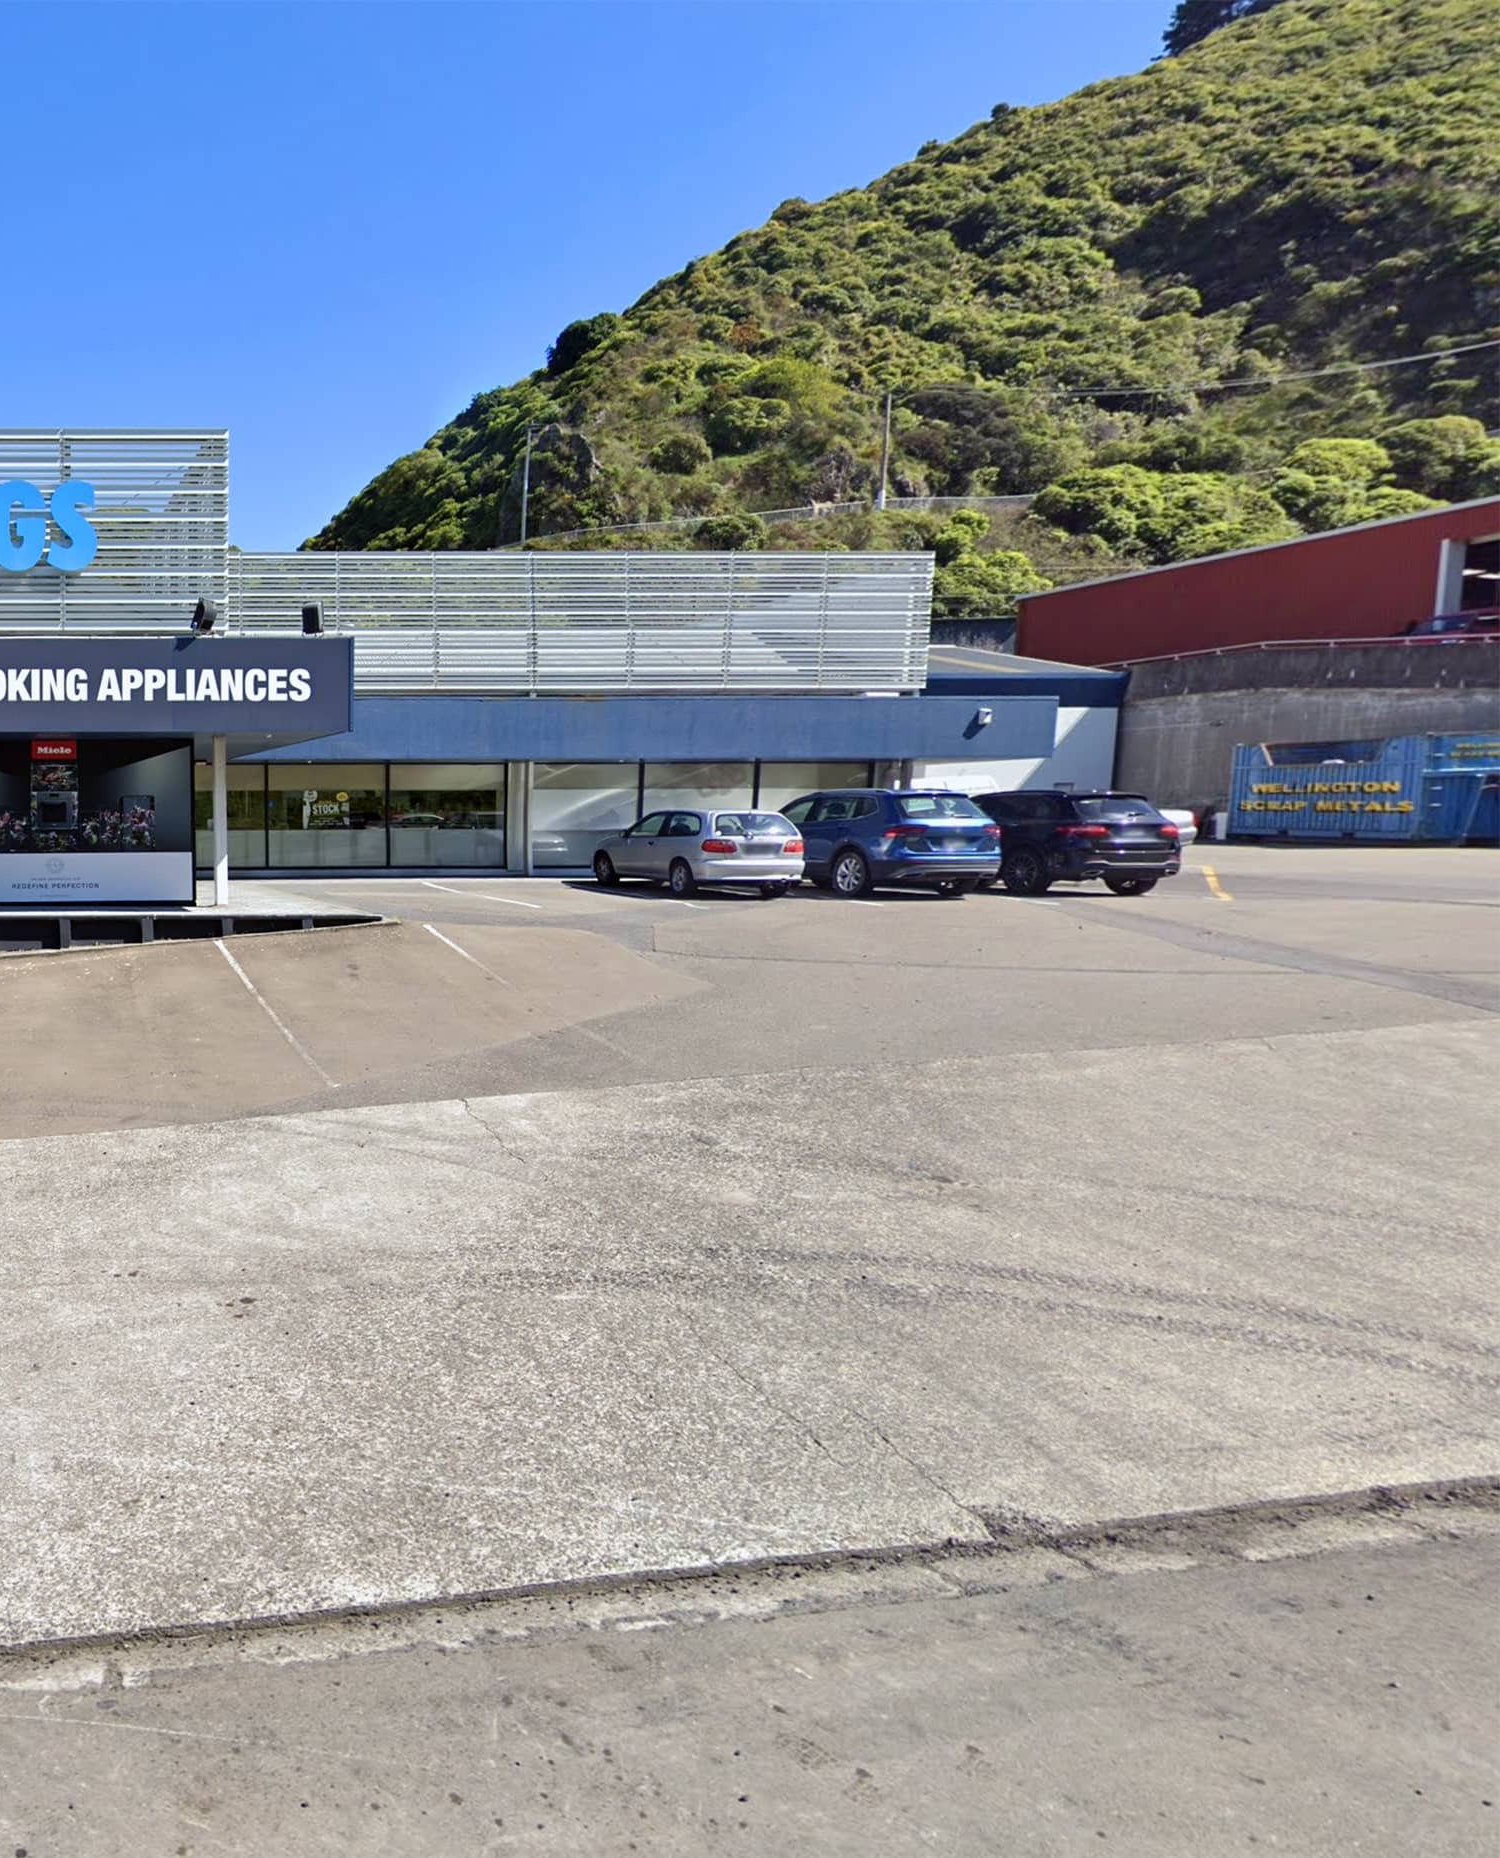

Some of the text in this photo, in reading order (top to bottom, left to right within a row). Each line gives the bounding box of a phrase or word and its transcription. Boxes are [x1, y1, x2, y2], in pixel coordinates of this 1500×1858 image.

[97, 667, 312, 702] APPLIANCES
[36, 746, 72, 754] Miele
[1251, 781, 1401, 794] WELLINGTON
[312, 804, 340, 816] STOCK
[1240, 800, 1414, 813] SCRAP METALS
[11, 882, 49, 890] REDEFINE
